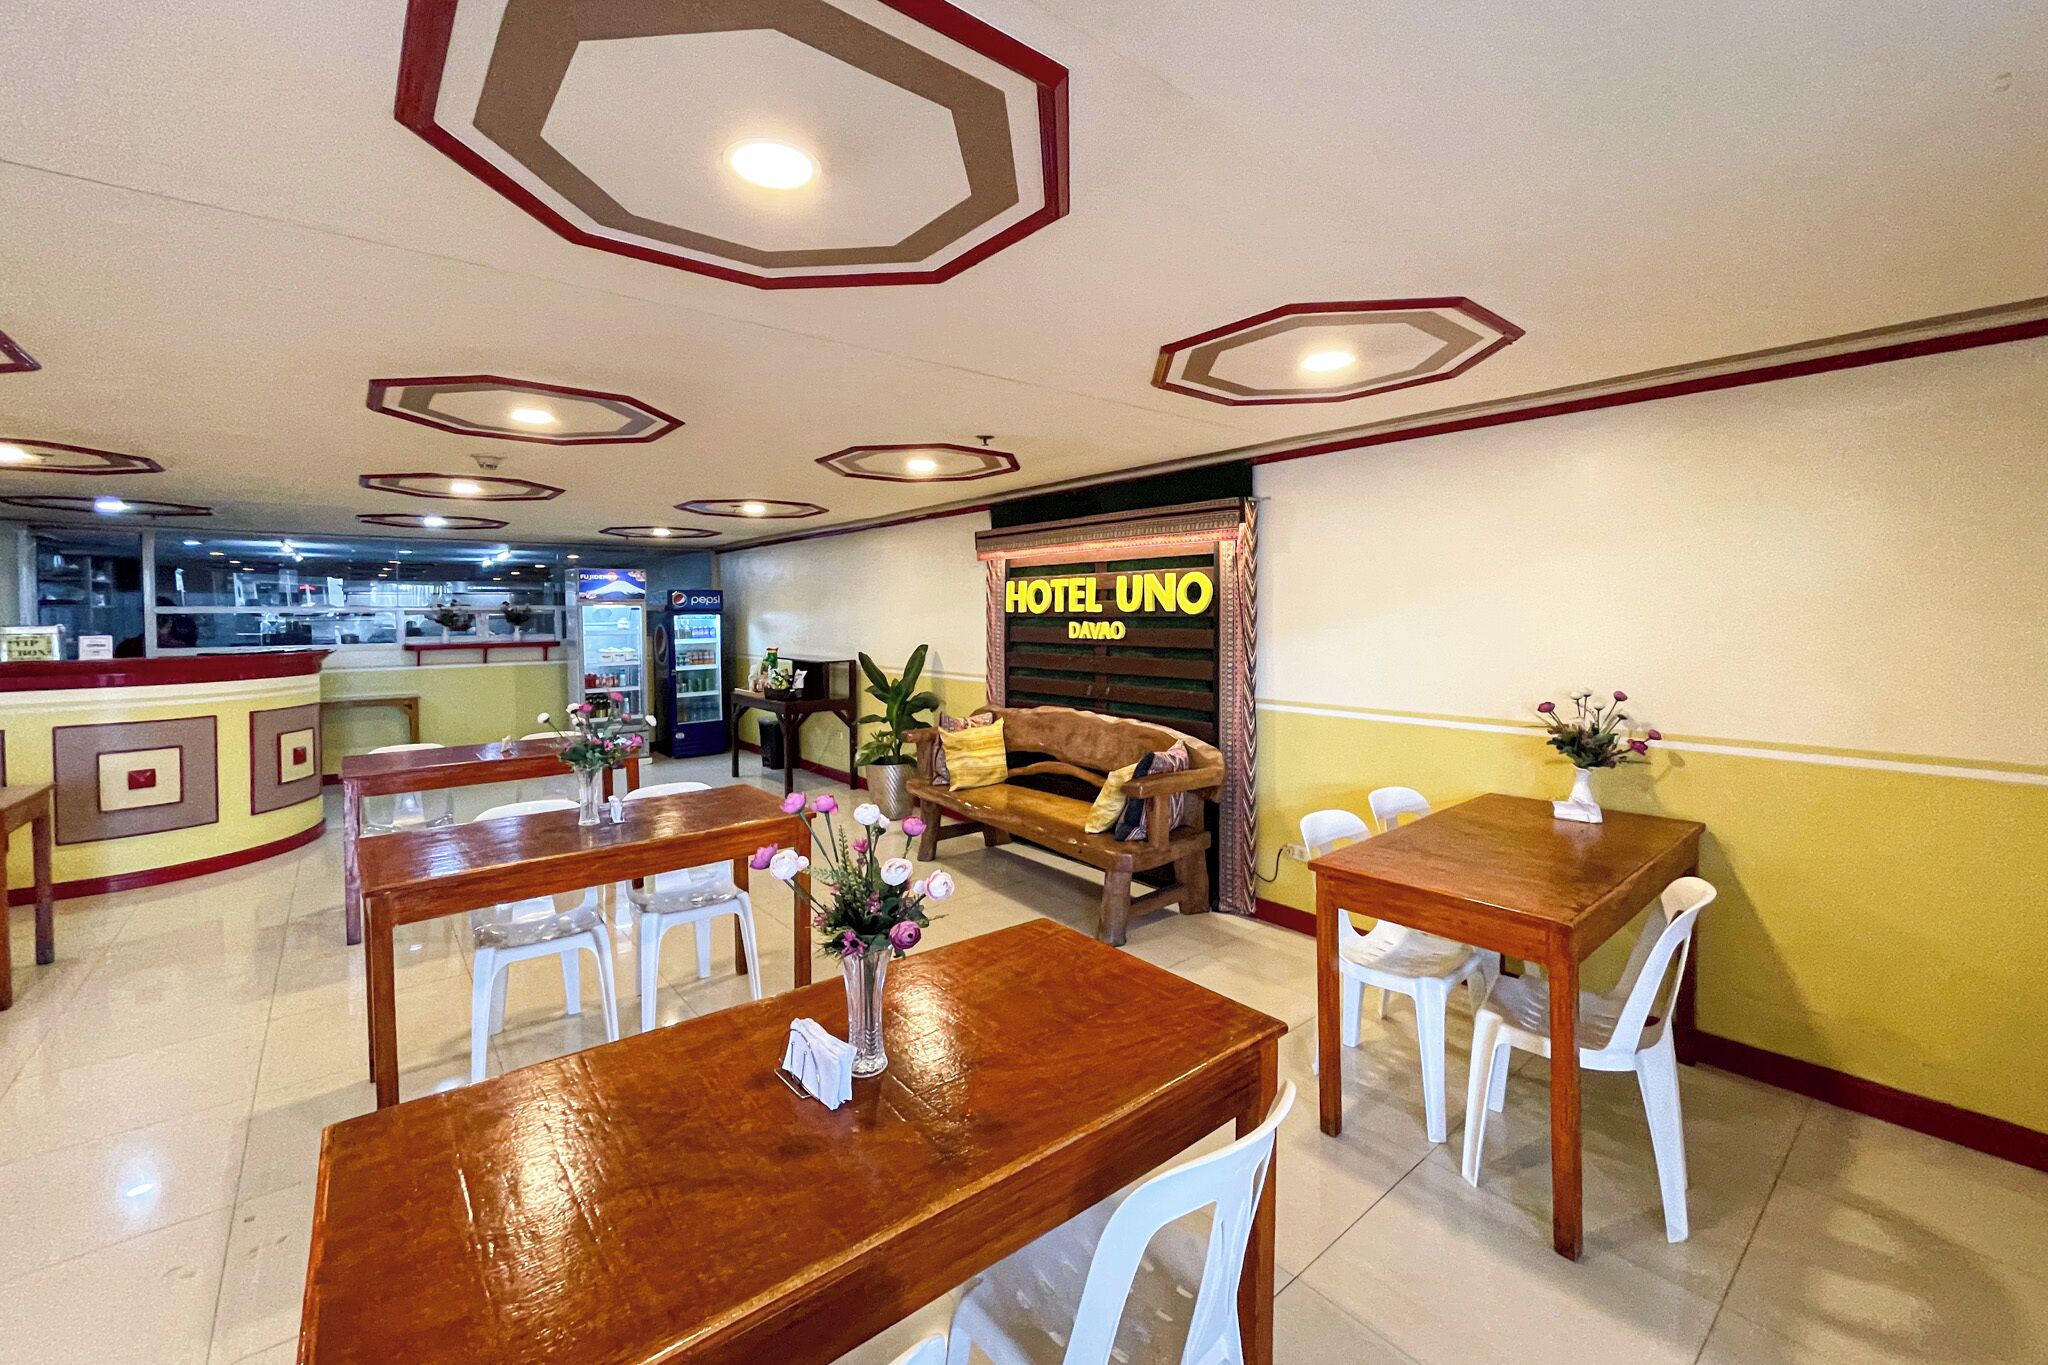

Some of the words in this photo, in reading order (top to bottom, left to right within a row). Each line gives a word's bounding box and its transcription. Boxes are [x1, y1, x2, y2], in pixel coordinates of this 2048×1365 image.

[1005, 577, 1103, 614] HOTEL
[1116, 571, 1213, 615] UNO
[691, 595, 720, 606] pepsi
[1068, 621, 1126, 639] DAVAO
[17, 649, 47, 657] BOX
